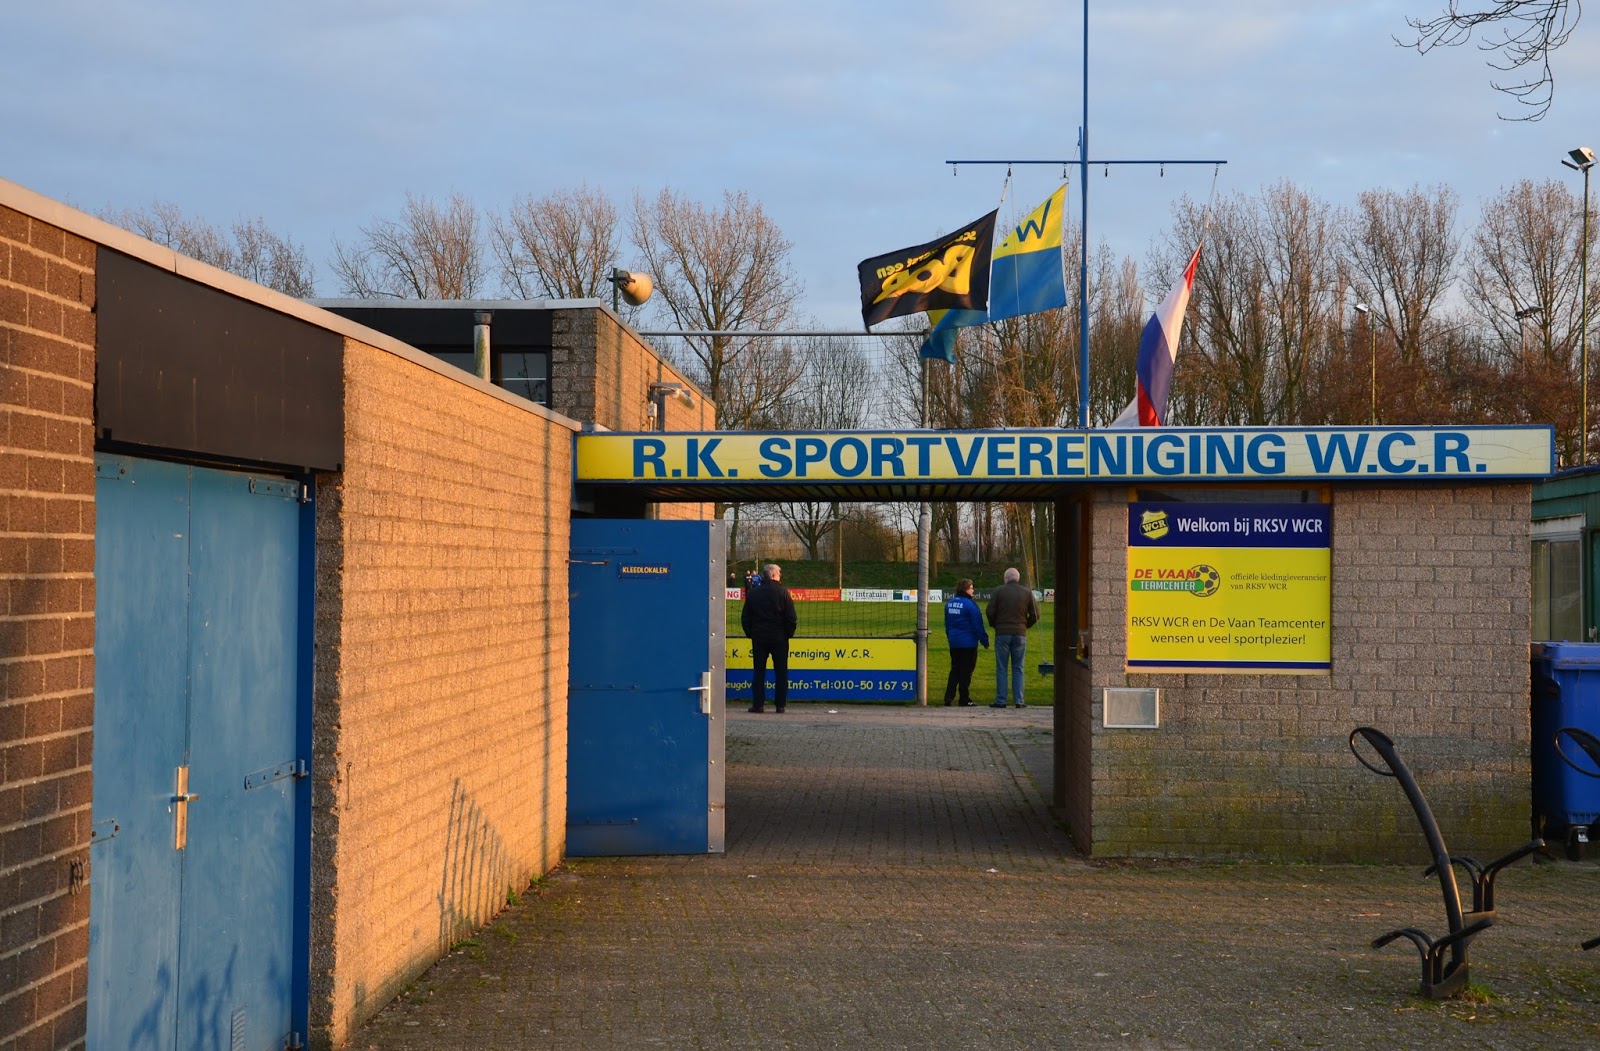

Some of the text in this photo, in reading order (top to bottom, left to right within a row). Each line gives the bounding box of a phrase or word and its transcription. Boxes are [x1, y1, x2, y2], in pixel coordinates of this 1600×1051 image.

[632, 432, 1487, 478] R.K. SPORTVERENIGING W.C.R.
[1142, 519, 1167, 532] WCR
[1177, 518, 1323, 536] Welkom bij RKSV WCR
[622, 566, 668, 574] KLEEDLOKALEN
[1134, 569, 1197, 579] DE VAAN
[1230, 573, 1327, 583] officiële kledingleverancier
[1140, 580, 1196, 591] TEAMCENTER
[1245, 582, 1268, 590] RKSV
[1269, 582, 1288, 590] WCR
[1131, 616, 1326, 629] RKSV WCR en De Vaan Teamcenter
[1151, 634, 1306, 646] wensen u veel sportplezier!
[835, 649, 874, 659] W.C.R.
[878, 681, 897, 691] 167
[902, 681, 914, 691] 91
